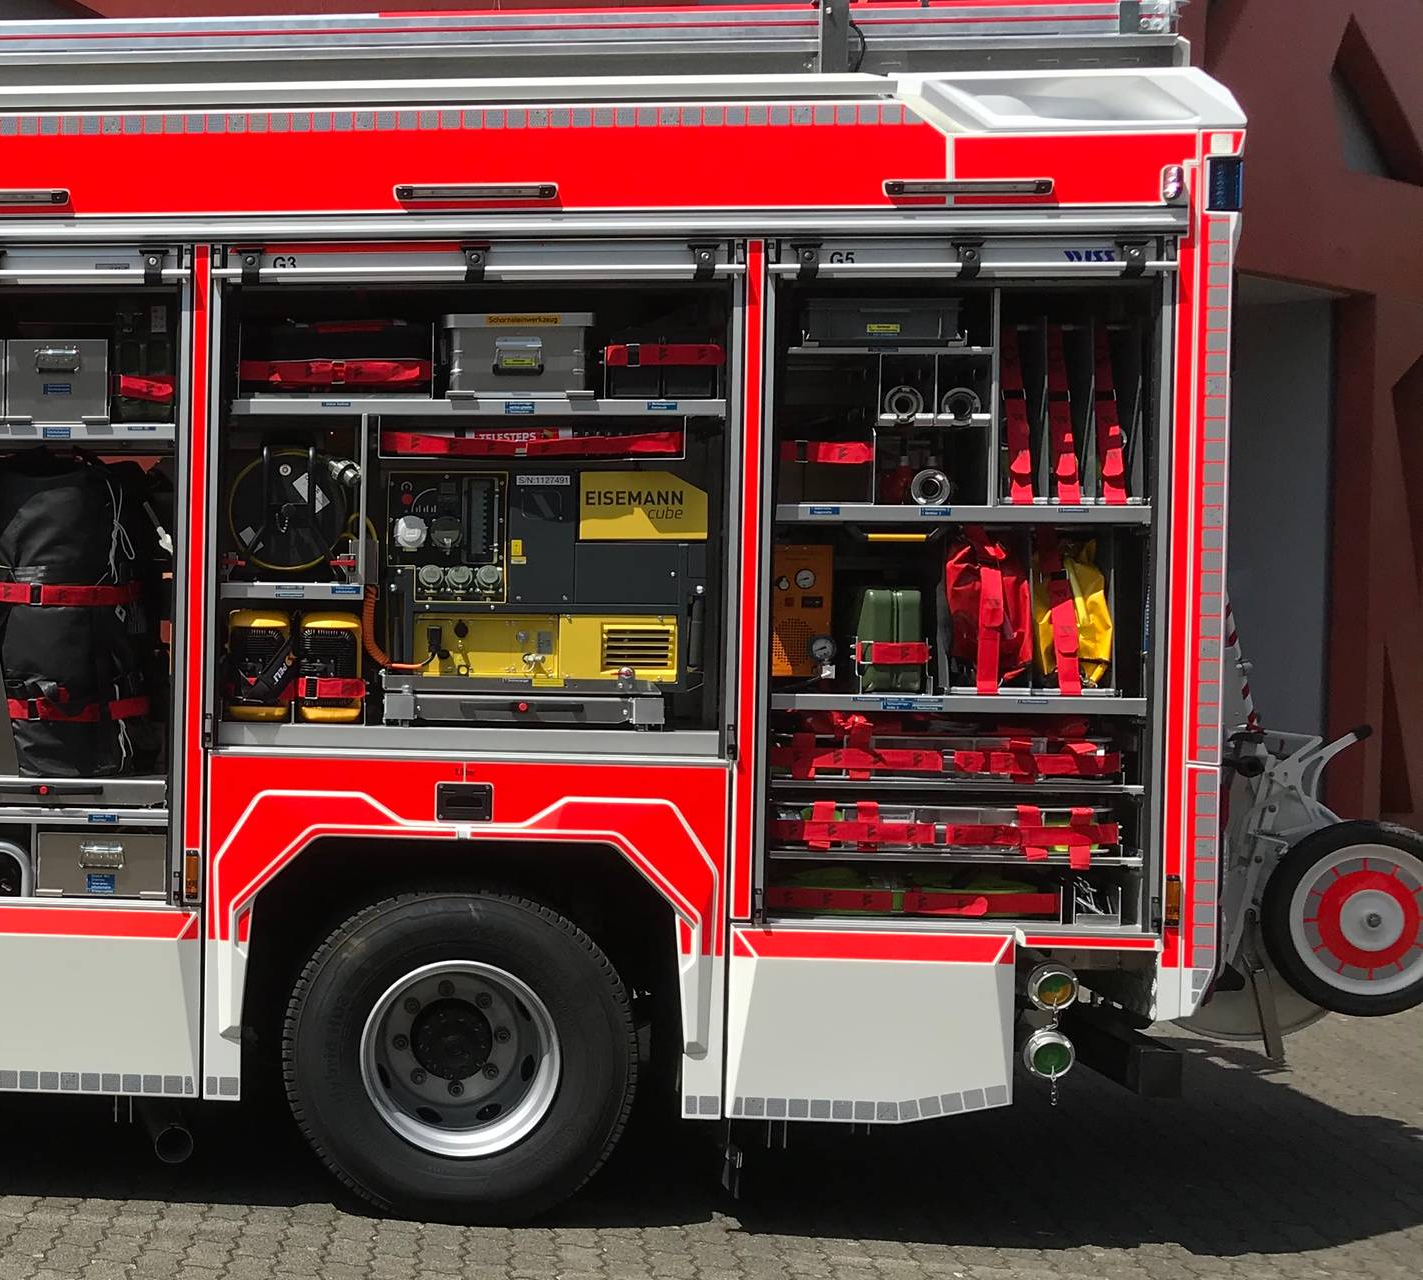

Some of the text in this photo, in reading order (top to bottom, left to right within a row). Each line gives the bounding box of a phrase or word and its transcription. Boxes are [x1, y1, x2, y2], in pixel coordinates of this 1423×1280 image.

[273, 256, 296, 269] G3
[830, 251, 854, 264] G5
[1063, 250, 1115, 262] WISS
[585, 490, 684, 505] EISEMANN
[648, 506, 683, 520] cube
